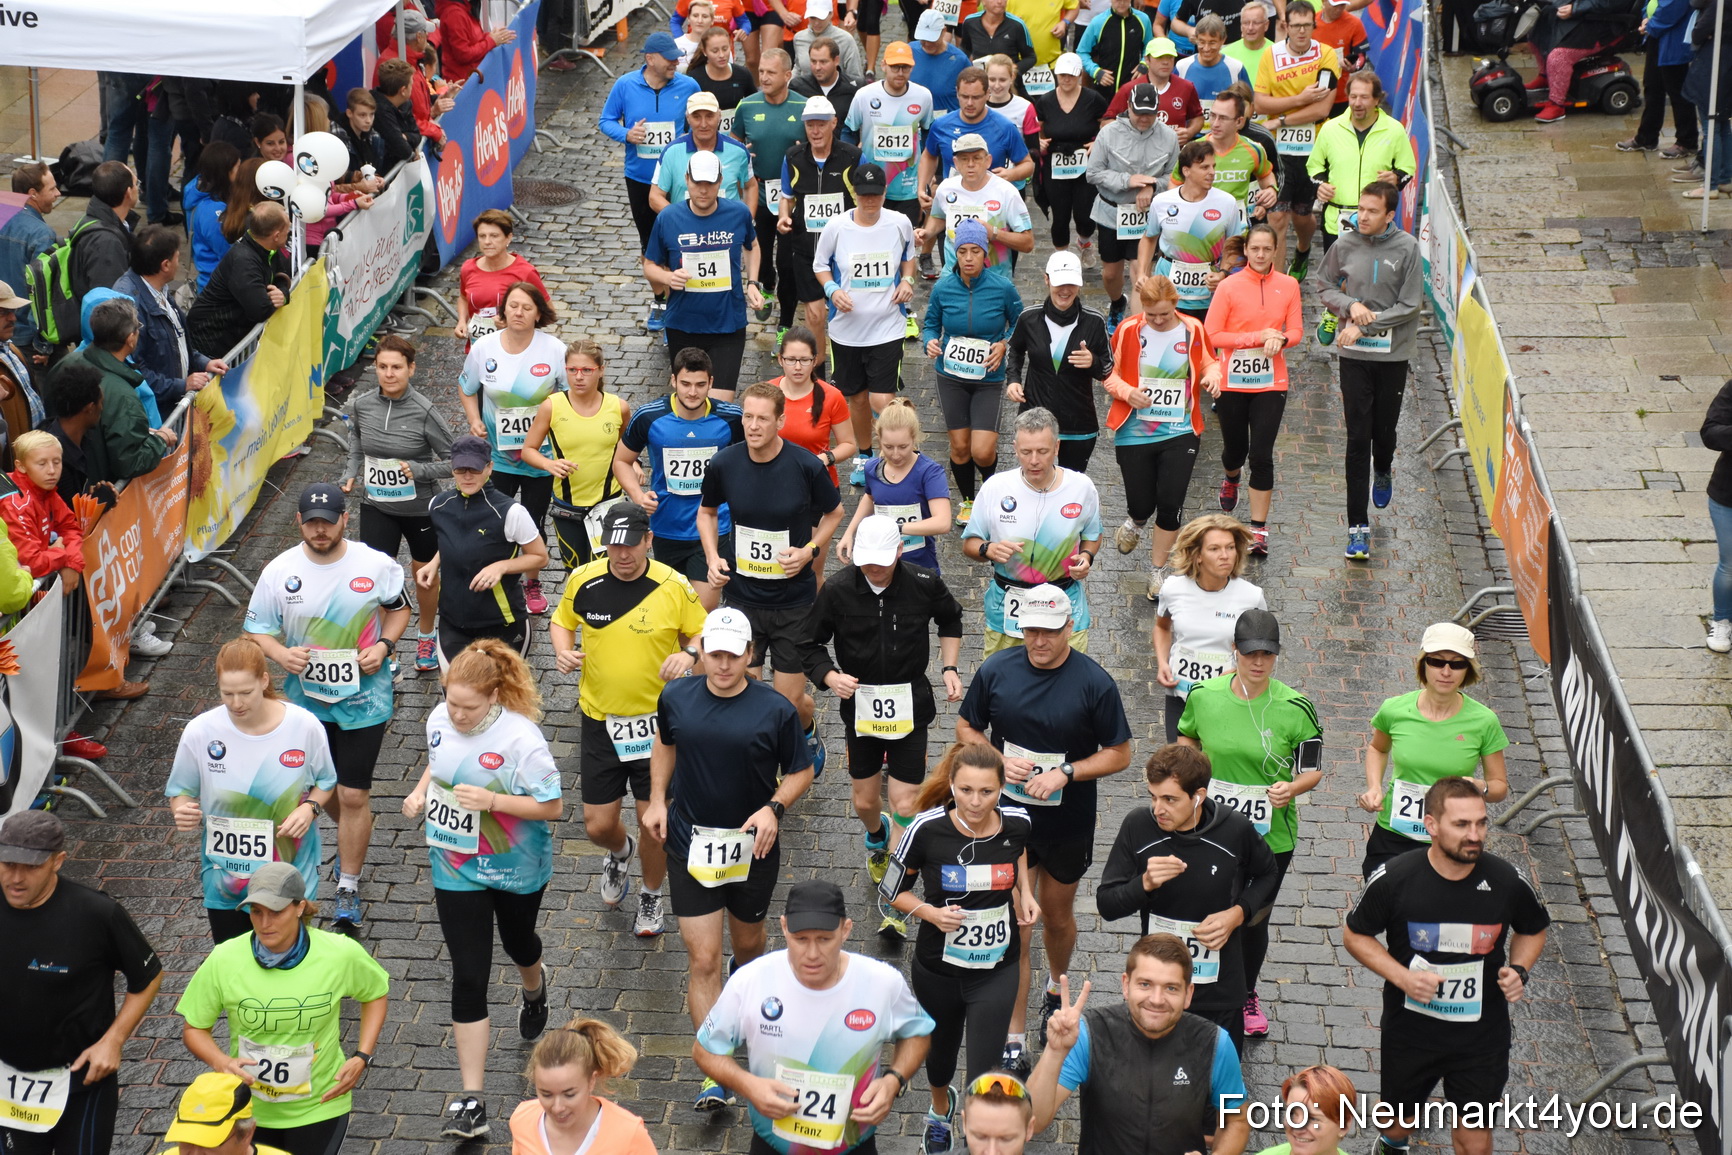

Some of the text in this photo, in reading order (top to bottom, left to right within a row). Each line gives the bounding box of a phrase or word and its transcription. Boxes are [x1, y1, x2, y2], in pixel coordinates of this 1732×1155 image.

[1024, 70, 1052, 84] 2472
[1276, 71, 1298, 82] MAX
[474, 109, 508, 171] Hervis
[878, 134, 910, 148] 2612
[1280, 128, 1312, 143] 2769
[1055, 152, 1085, 166] 2637
[809, 202, 841, 218] 2464
[697, 261, 717, 278] 54
[853, 261, 890, 278] 2111
[864, 279, 881, 287] Tanja
[1173, 270, 1207, 287] 3082
[948, 344, 985, 365] 2505
[952, 362, 975, 374] Claudia
[1232, 357, 1270, 374] 2564
[1241, 375, 1261, 384] Katrin
[1146, 388, 1182, 407] 2267
[1149, 408, 1172, 417] Andrea
[501, 416, 539, 435] 240
[369, 465, 409, 487] 2095
[376, 487, 402, 497] Claudia
[750, 541, 773, 561] 53
[747, 563, 773, 573] Robert
[352, 580, 373, 589] Hervis
[586, 612, 612, 621] Robert
[304, 661, 354, 684] 2303
[1177, 657, 1225, 682] 2831
[318, 683, 340, 696] Heiko
[872, 697, 896, 719] 93
[613, 714, 659, 741] 2130
[872, 722, 898, 733] Harald
[624, 742, 652, 754] Robert
[207, 761, 226, 770] PARTL
[282, 753, 305, 764] Hervis
[481, 754, 502, 767] Hervis
[428, 798, 474, 834] 2054
[212, 830, 267, 858] 2055
[432, 829, 458, 845] Agnes
[703, 841, 742, 865] 114
[225, 859, 251, 873] Ingrid
[476, 856, 492, 867] 17.
[953, 919, 1008, 947] 2399
[967, 951, 991, 962] Anne
[848, 1012, 873, 1026] Hervis
[760, 1023, 783, 1033] PARTL
[257, 1058, 290, 1084] 26
[8, 1074, 54, 1104] 177
[793, 1088, 837, 1120] 124
[10, 1105, 40, 1123] Stefan
[793, 1121, 823, 1138] Franz
